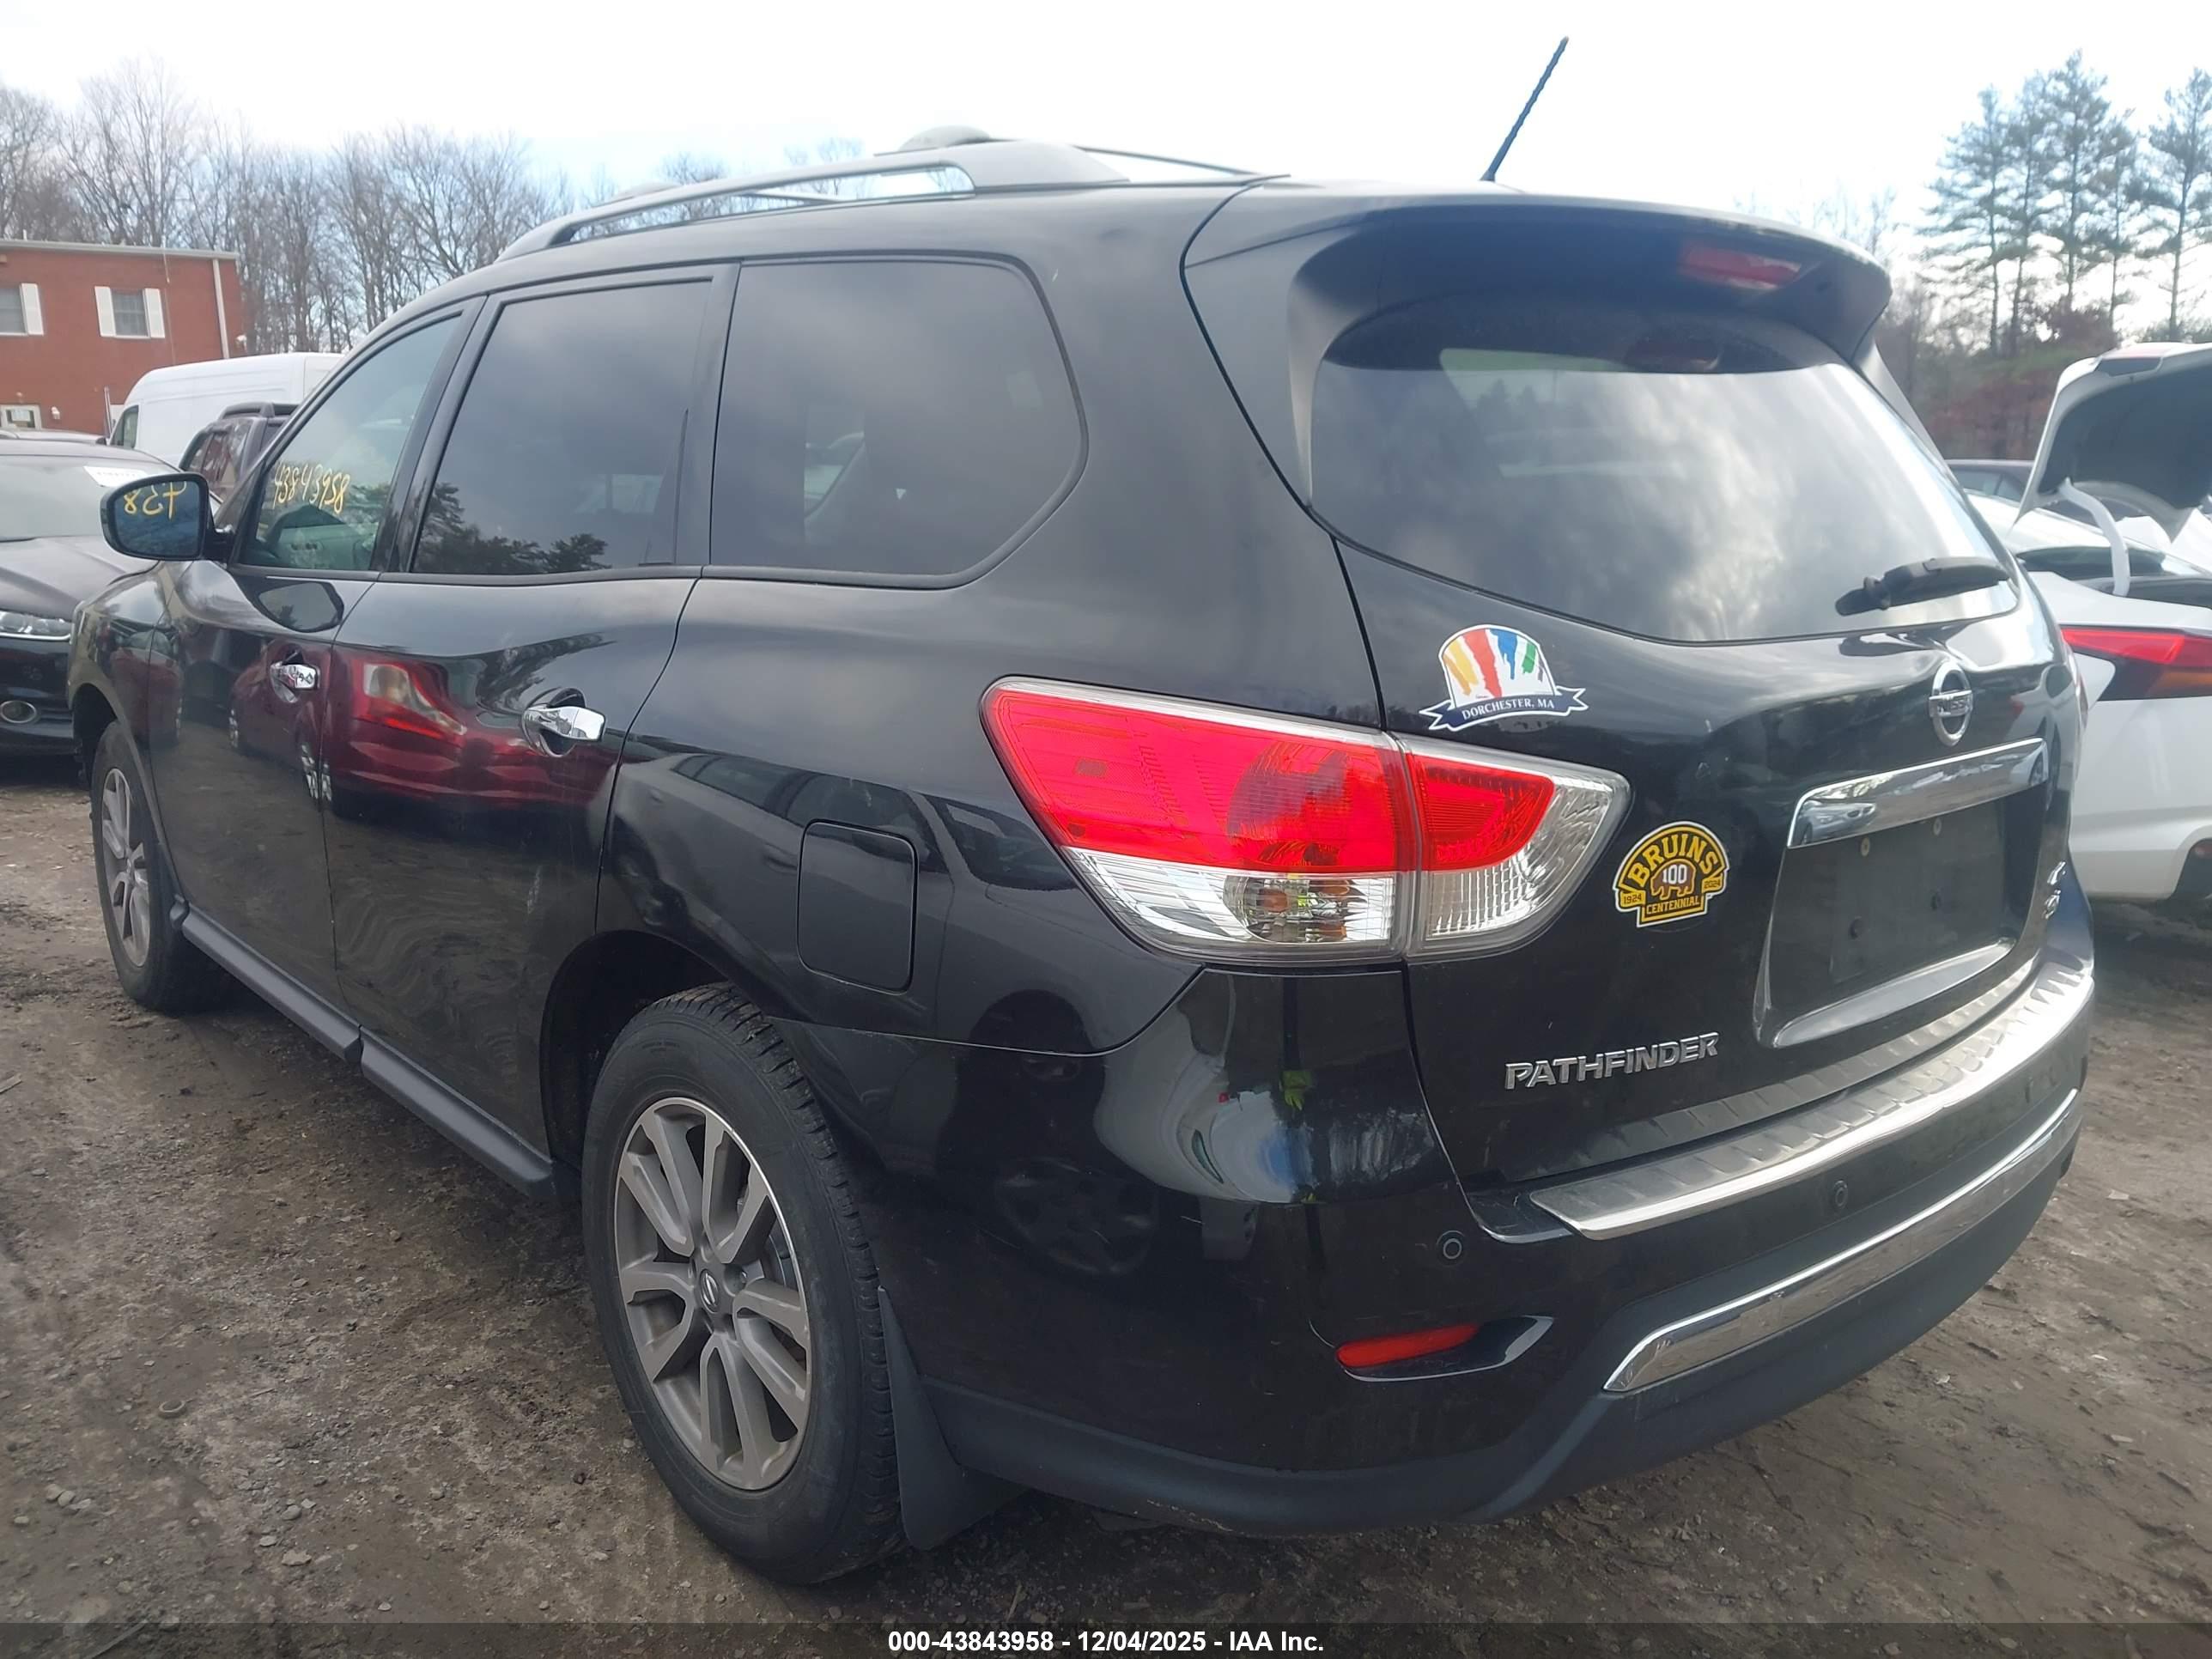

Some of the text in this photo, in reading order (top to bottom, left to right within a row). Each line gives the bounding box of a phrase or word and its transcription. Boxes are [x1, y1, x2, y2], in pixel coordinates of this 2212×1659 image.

[272, 460, 350, 514] 43843958
[1462, 698, 1555, 720] DORCHESTER, MA
[1627, 833, 1719, 888] BRUINS
[1662, 863, 1688, 884] 100
[1704, 879, 1721, 890] 2024
[1623, 893, 1643, 905] 1924
[1646, 896, 1700, 915] CENTENNIAL
[1504, 1031, 1719, 1090] PATHFINDER
